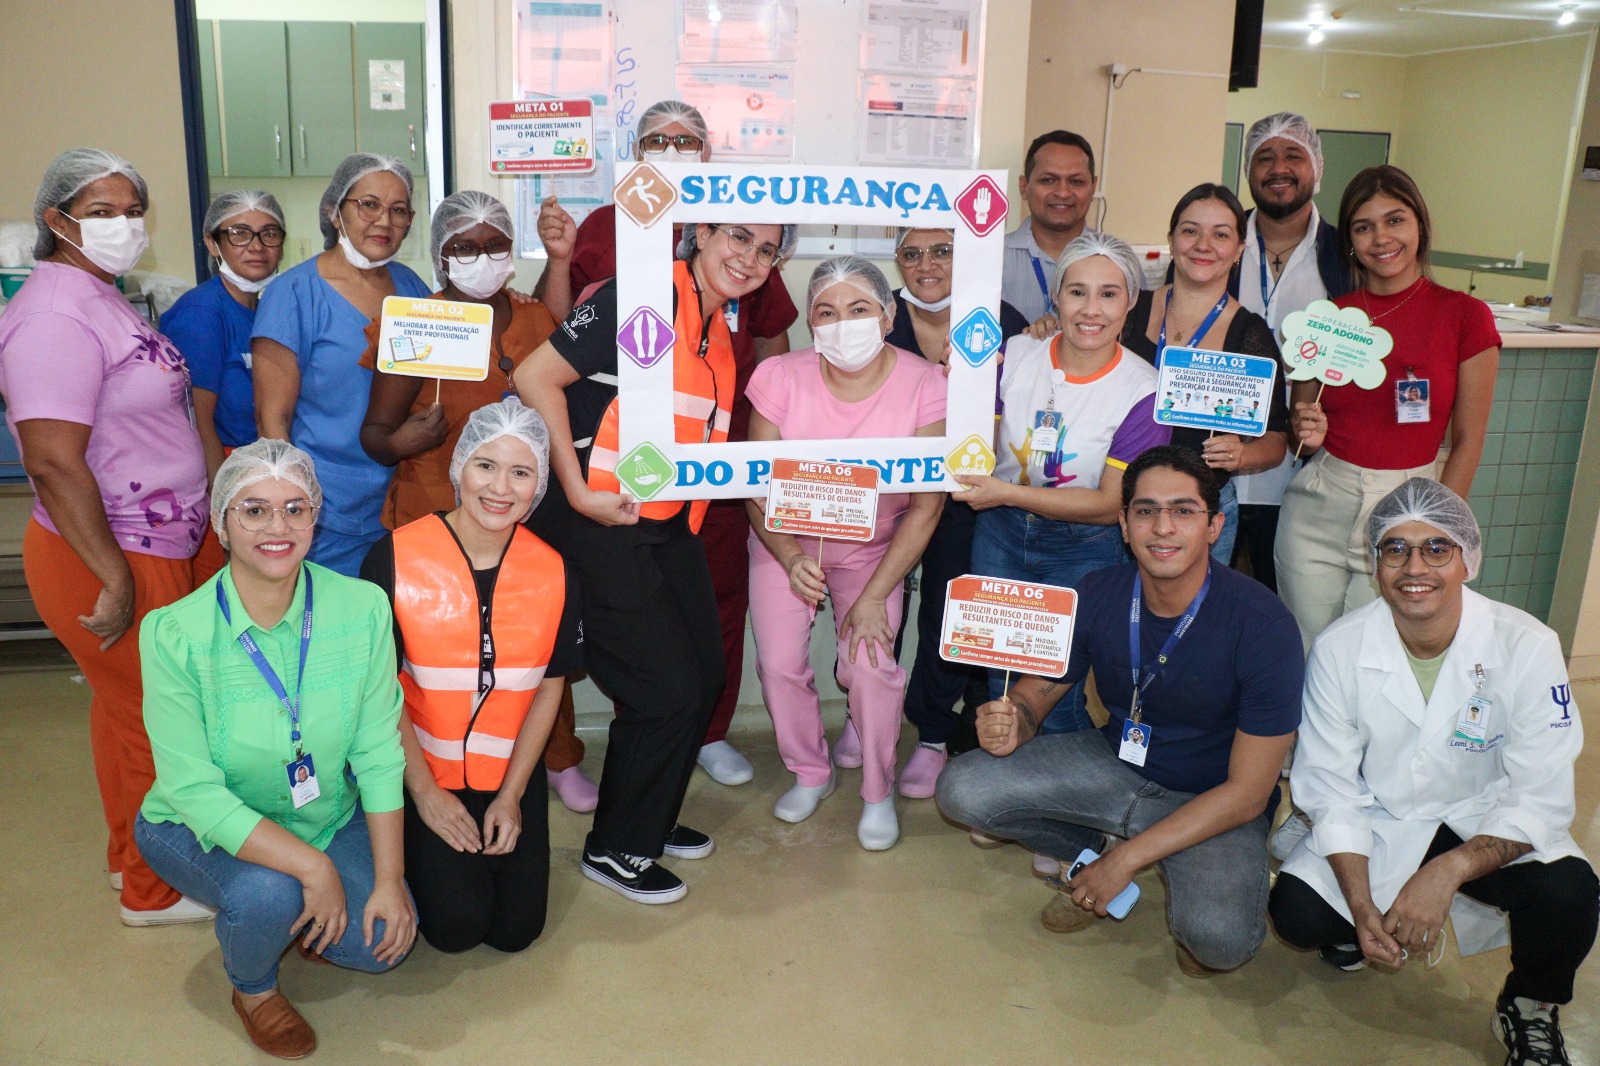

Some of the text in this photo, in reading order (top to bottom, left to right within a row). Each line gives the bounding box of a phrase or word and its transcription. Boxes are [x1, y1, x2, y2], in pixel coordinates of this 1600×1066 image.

[515, 102, 564, 112] META 01
[680, 175, 951, 219] SEGURANÇA
[412, 303, 464, 315] META 02
[394, 321, 428, 329] MELHORAR
[436, 324, 479, 334] COMUNICAÇÃO
[1306, 319, 1374, 346] ZERO ADORNO
[1322, 316, 1364, 334] OPERAÇÃO
[425, 331, 469, 340] PROFISSIONAIS
[1192, 353, 1246, 368] META 03
[1175, 374, 1204, 383] GARANTIR
[1212, 379, 1246, 389] SEGURANÇA
[1217, 373, 1264, 384] MEDICAMENTOS
[1169, 381, 1205, 391] PRESCRIÇÃO
[1211, 386, 1260, 398] ADMINISTRAÇÃO
[674, 456, 945, 487] DO PNTE
[799, 463, 852, 476] META 06
[781, 483, 808, 492] REDUZIR
[845, 489, 866, 497] DANOS
[783, 490, 825, 501] RESULTANTES
[837, 496, 862, 504] QUEDAS
[981, 582, 1044, 599] META 06
[974, 592, 1008, 602] SEGURANÇA
[1019, 598, 1046, 606] PACIENTE
[959, 604, 991, 615] REDUZIR
[1000, 609, 1020, 619] RISCO
[1024, 612, 1032, 620] DE
[1034, 614, 1060, 624] DANOS
[962, 613, 1012, 626] RESULTANTES
[1025, 622, 1054, 633] QUEDAS
[960, 650, 978, 658] Confirme
[979, 653, 994, 662] sempre
[1010, 658, 1028, 666] qualquer
